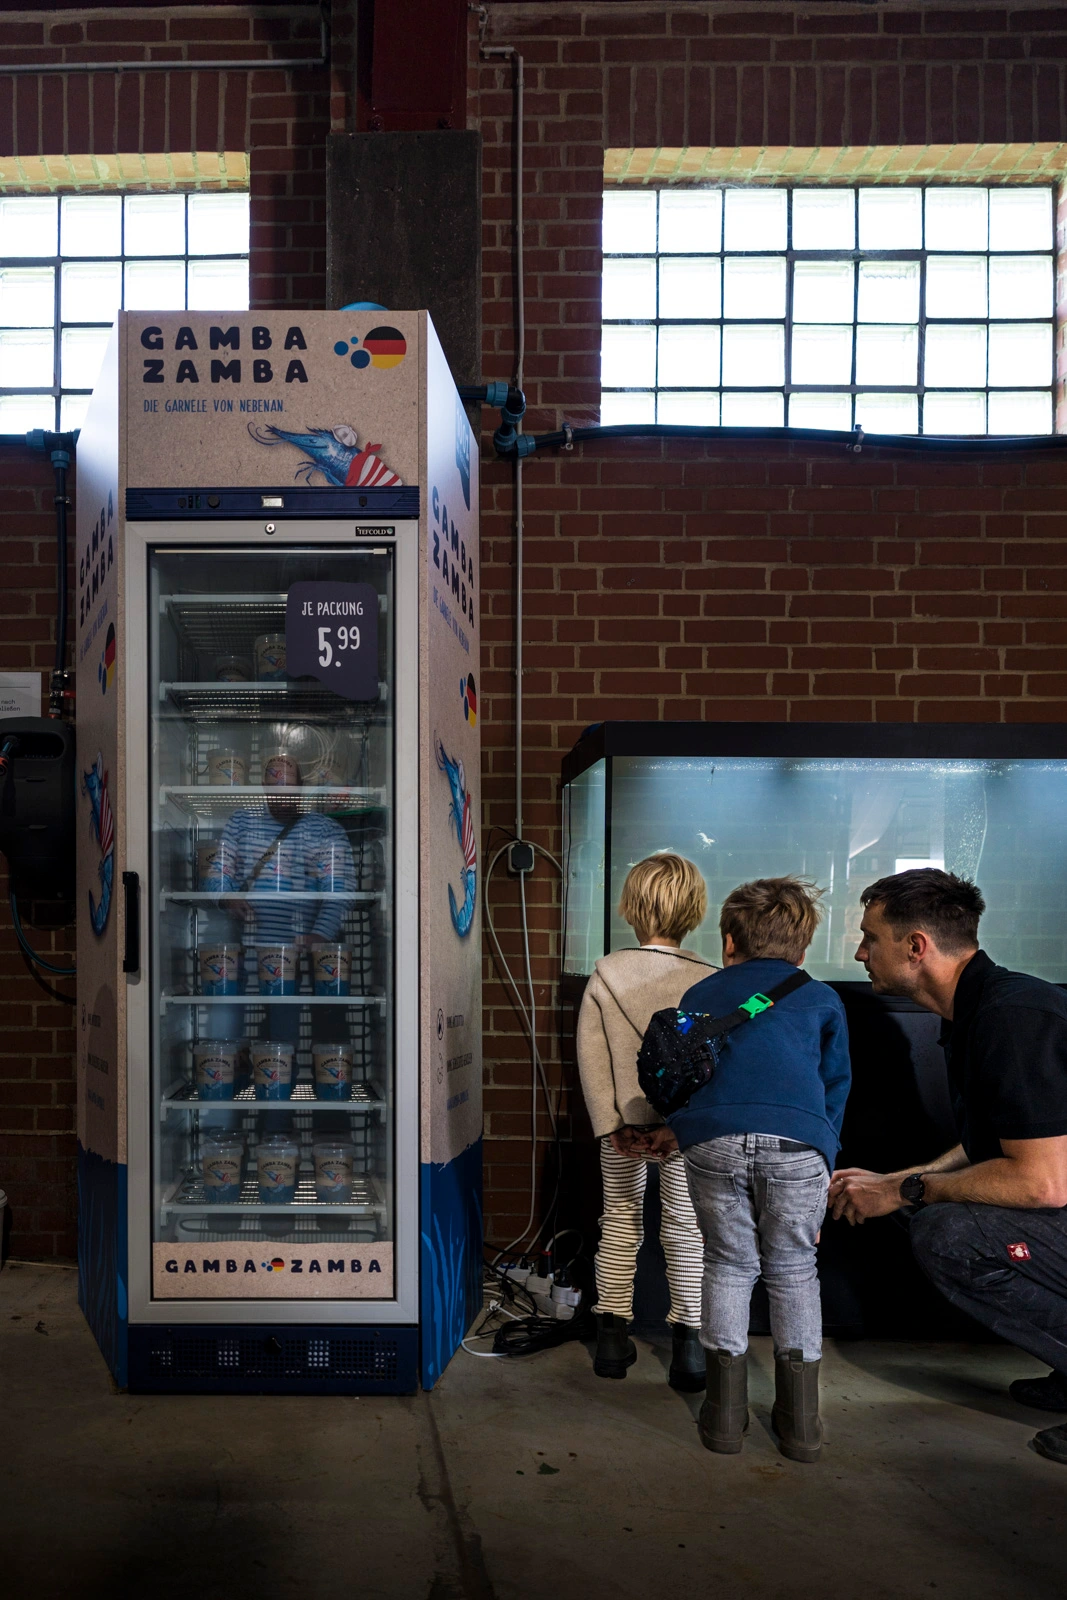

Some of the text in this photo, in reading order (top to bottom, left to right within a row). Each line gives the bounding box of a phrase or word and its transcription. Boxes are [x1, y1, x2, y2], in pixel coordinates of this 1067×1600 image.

[140, 326, 308, 350] GAMBA
[142, 359, 309, 383] ZAMBA
[143, 399, 288, 413] DIE GARNELE VON NEBENAN.
[80, 488, 113, 588] GAMBA
[432, 485, 474, 589] GAMBA
[79, 534, 113, 628] ZAMBA
[432, 529, 475, 629] ZAMBA
[301, 601, 364, 616] JE PACKUNG
[318, 626, 360, 668] 5.99
[165, 1259, 382, 1273] GAMBA ZAMBA
